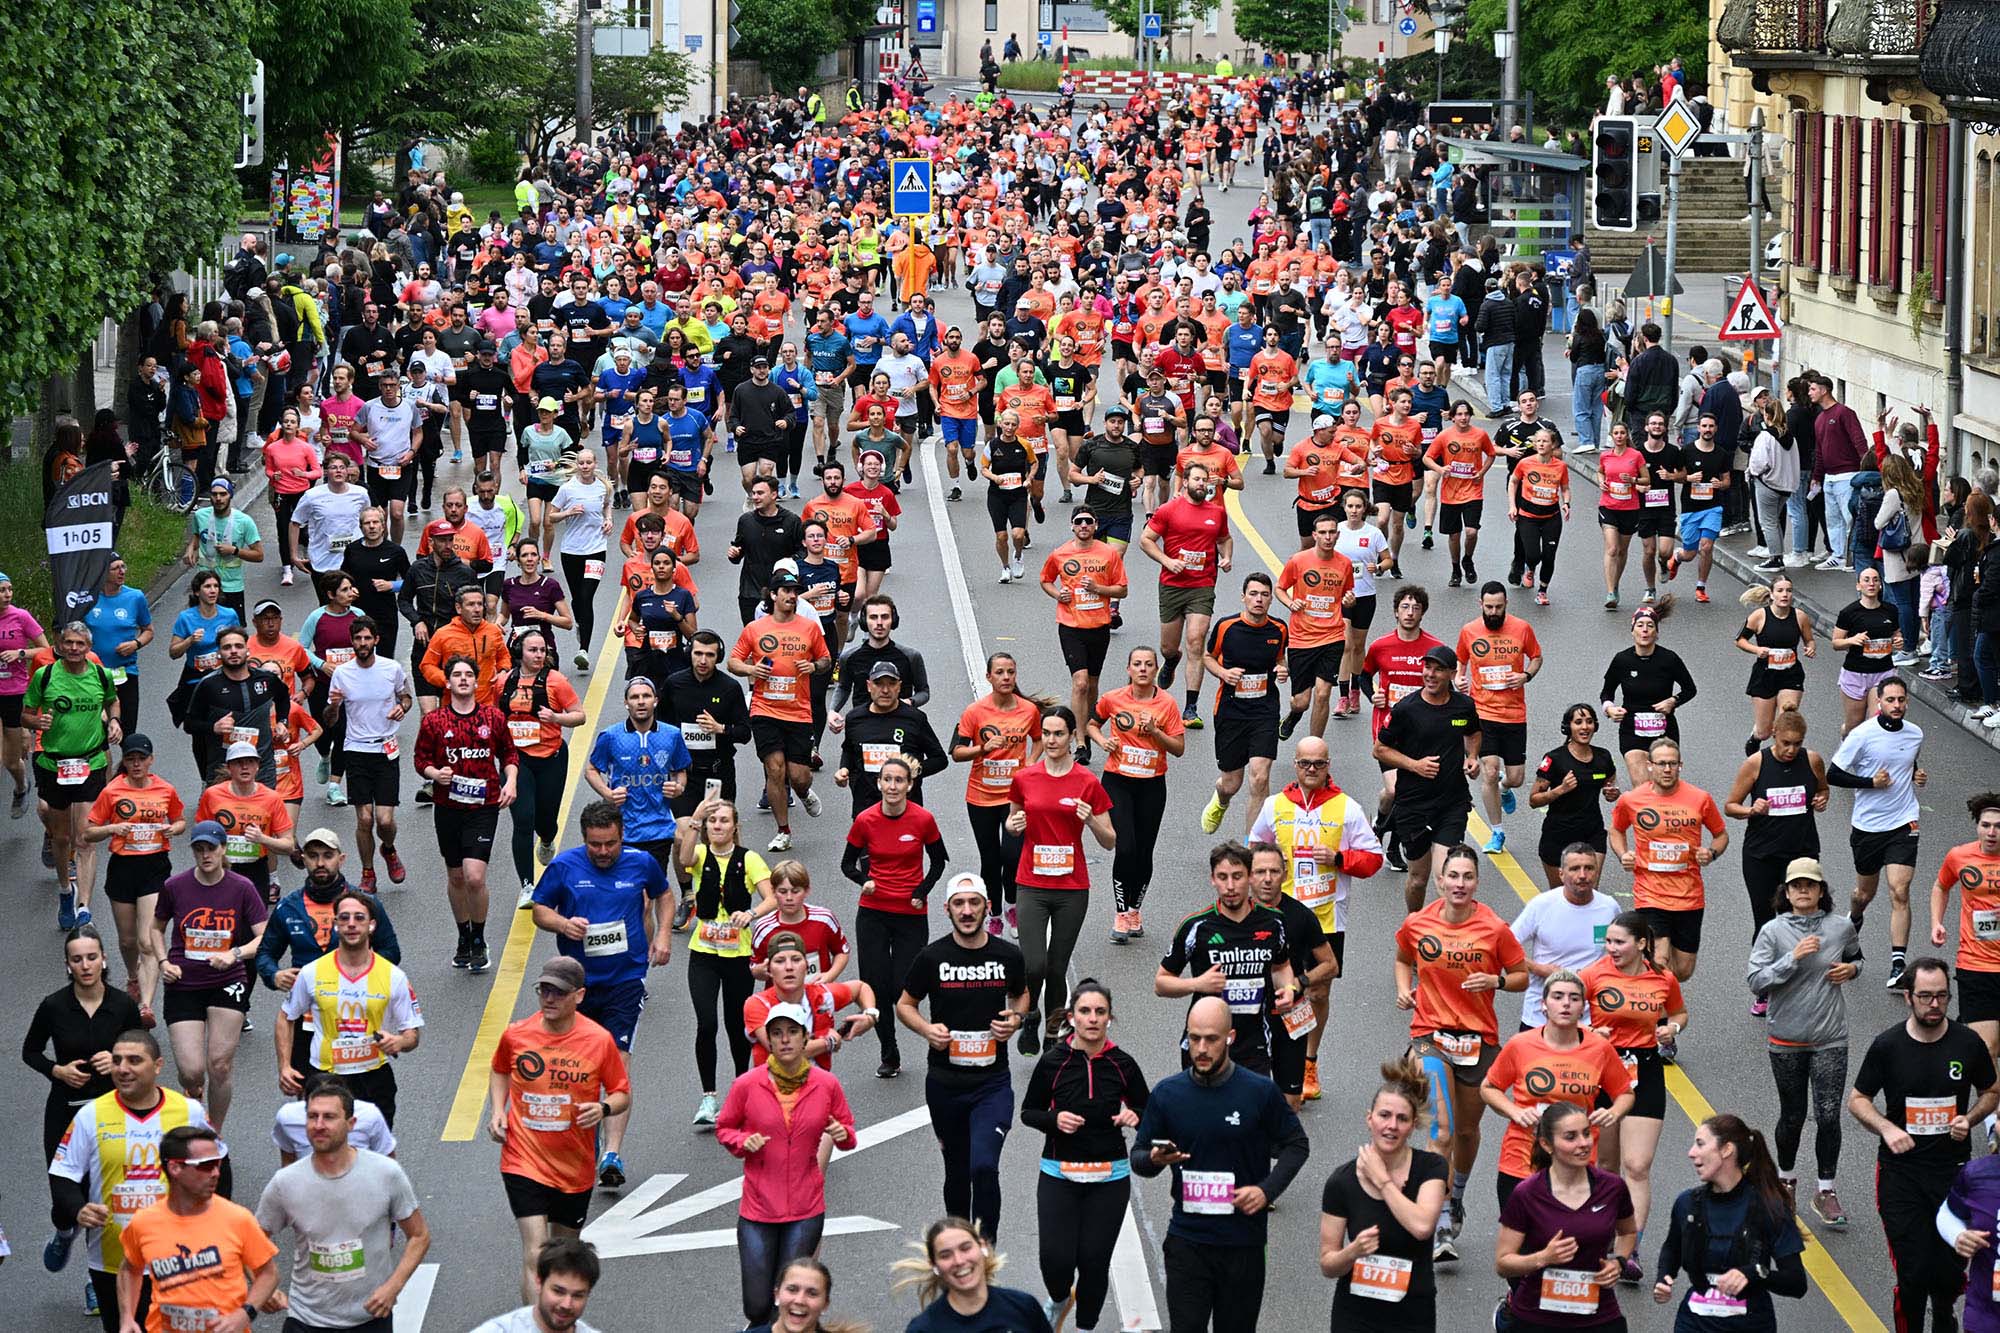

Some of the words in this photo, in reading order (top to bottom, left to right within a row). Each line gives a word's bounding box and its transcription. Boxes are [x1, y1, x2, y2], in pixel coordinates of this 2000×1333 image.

[81, 492, 108, 507] BCN
[63, 529, 102, 546] 1h05
[1323, 578, 1344, 587] TOUR
[76, 594, 94, 604] TOUR
[781, 643, 806, 651] TOUR
[769, 682, 789, 691] 8321
[75, 703, 98, 711] TOUR
[684, 732, 712, 741] 26006
[459, 746, 490, 758] Tezos
[457, 784, 480, 795] 6412
[140, 809, 169, 817] TOUR
[133, 832, 155, 840] 8027
[1114, 880, 1124, 911] NIKE
[587, 933, 622, 946] 25984
[1208, 947, 1272, 964] Emirates
[1446, 951, 1482, 963] TOUR
[939, 962, 1006, 981] CrossFit
[1236, 962, 1264, 974] BETTER
[1228, 989, 1257, 1001] 6637
[1629, 1001, 1664, 1011] TOUR
[959, 1040, 988, 1052] 8657
[341, 1047, 371, 1059] 8726
[560, 1059, 579, 1067] BCN
[549, 1069, 589, 1083] TOUR
[1570, 1072, 1589, 1080] BCN
[1186, 1183, 1228, 1197] 10144
[318, 1253, 353, 1267] 4098
[152, 1257, 180, 1277] ROC
[1362, 1268, 1397, 1284] 8771
[1552, 1281, 1590, 1297] 8604
